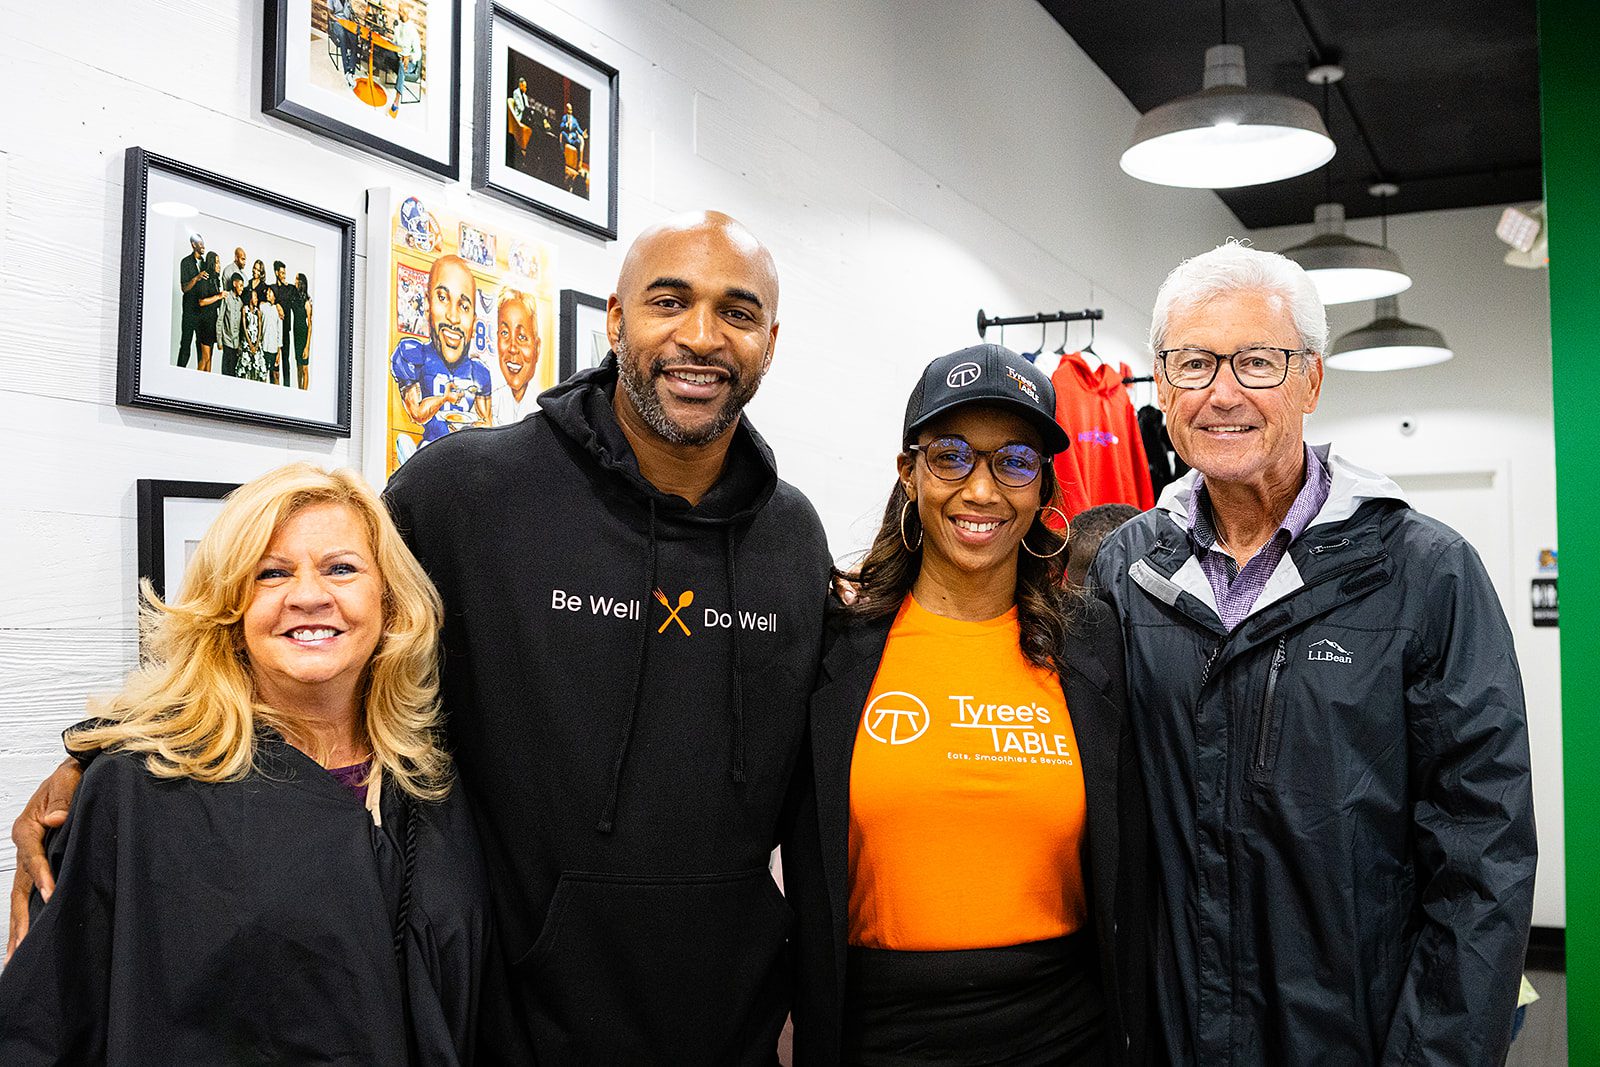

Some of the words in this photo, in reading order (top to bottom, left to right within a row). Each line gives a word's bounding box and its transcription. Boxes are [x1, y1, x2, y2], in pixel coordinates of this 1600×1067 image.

[1006, 373, 1040, 404] TABLE
[551, 589, 582, 612] Be
[589, 594, 640, 621] Well
[704, 608, 732, 628] Do
[738, 610, 777, 632] Well
[948, 695, 1051, 726] Tyree's
[951, 722, 1070, 757] TABLE
[947, 751, 971, 761] Eats,
[975, 753, 1027, 763] Smoothies
[1030, 756, 1037, 764] &
[1040, 757, 1073, 766] Beyond
